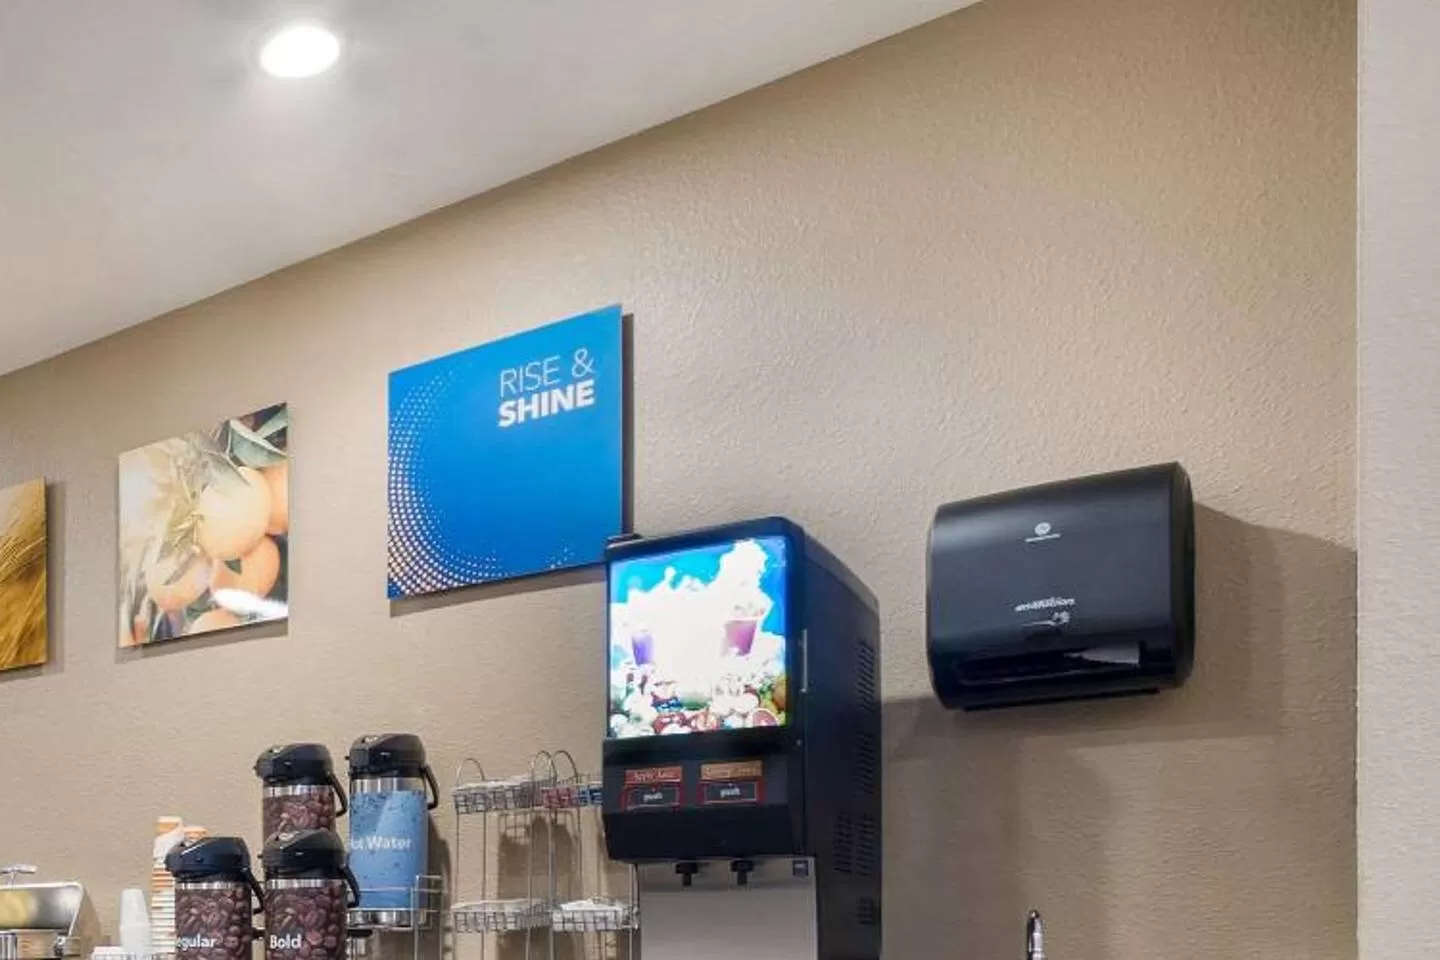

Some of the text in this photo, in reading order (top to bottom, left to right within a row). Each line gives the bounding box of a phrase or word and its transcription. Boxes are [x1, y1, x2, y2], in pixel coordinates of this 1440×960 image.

[500, 347, 596, 399] RISE &
[497, 379, 595, 428] SHINE
[366, 834, 413, 850] Water
[269, 933, 302, 949] Bold
